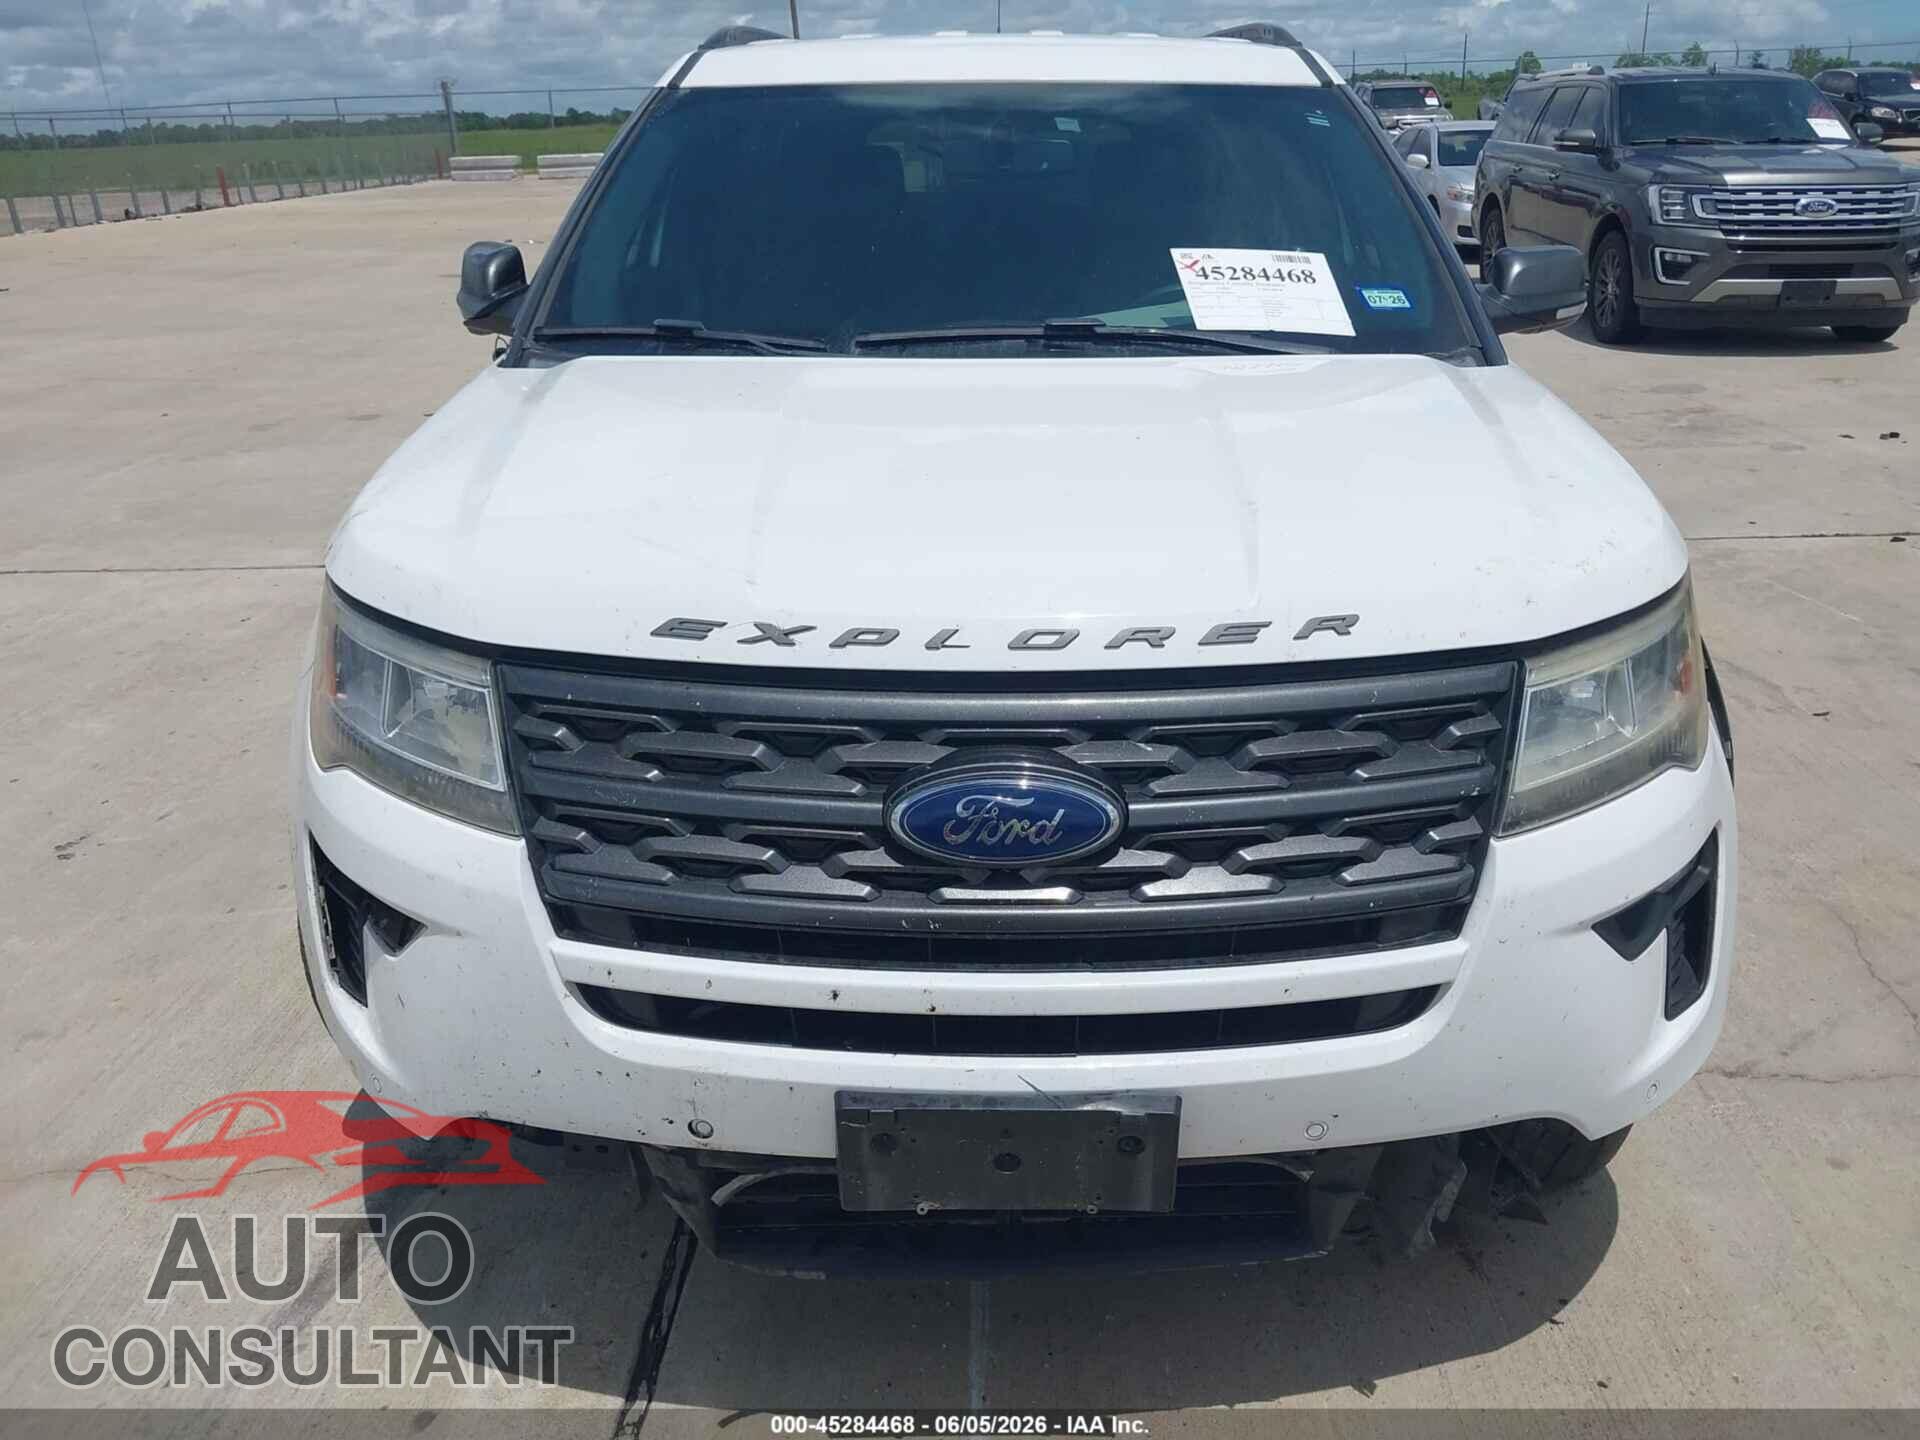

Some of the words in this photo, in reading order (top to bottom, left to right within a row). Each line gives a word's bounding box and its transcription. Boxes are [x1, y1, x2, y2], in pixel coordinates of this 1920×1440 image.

[1196, 265, 1316, 285] 45284468
[650, 613, 1361, 651] EXPLORER
[943, 795, 1065, 846] Ford
